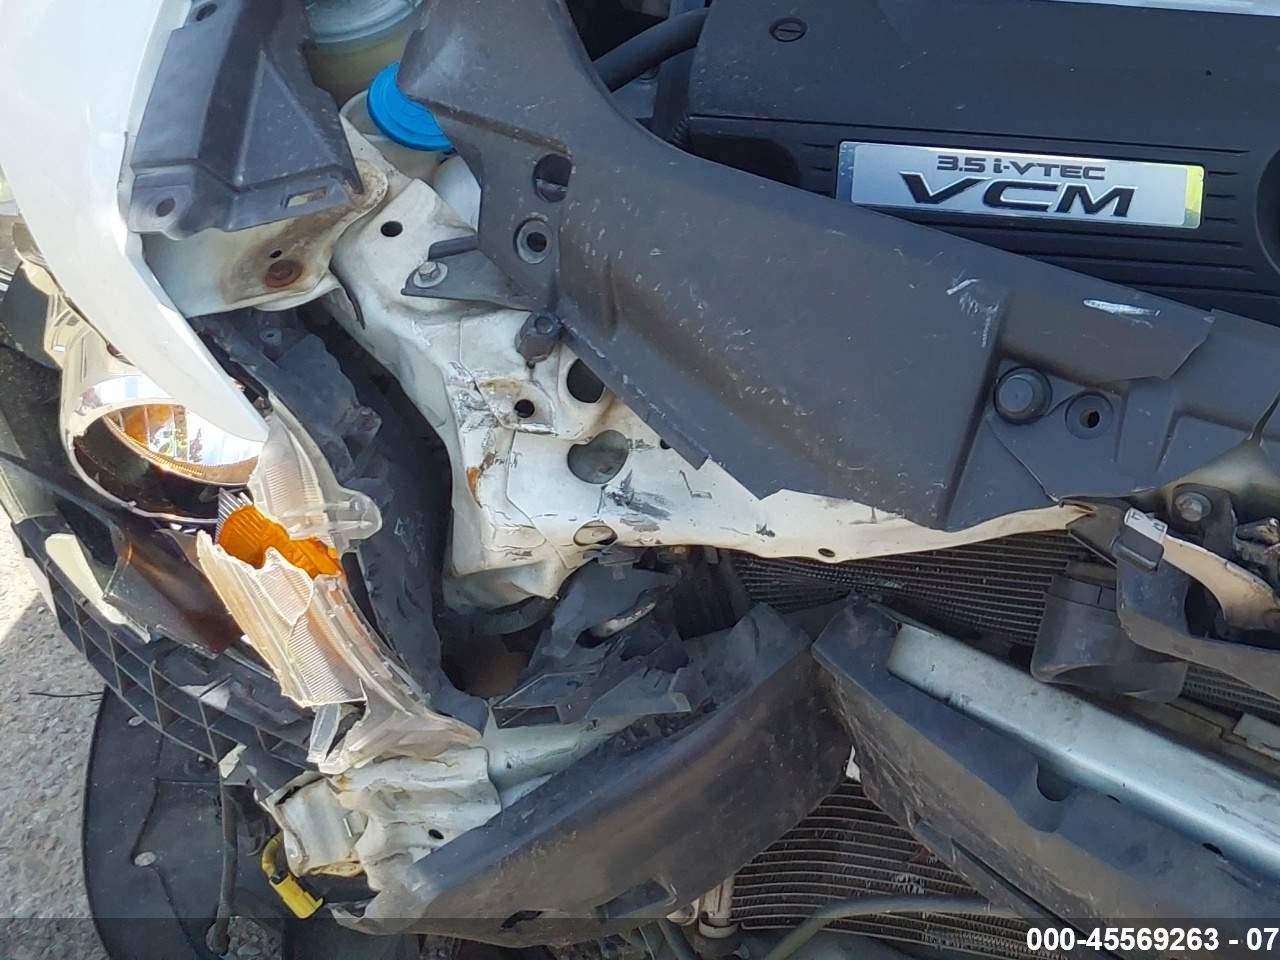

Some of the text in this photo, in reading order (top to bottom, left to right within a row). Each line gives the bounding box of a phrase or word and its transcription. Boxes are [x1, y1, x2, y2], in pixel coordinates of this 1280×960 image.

[936, 155, 1106, 181] 3.5 i-VTEC
[900, 171, 1139, 218] VCM
